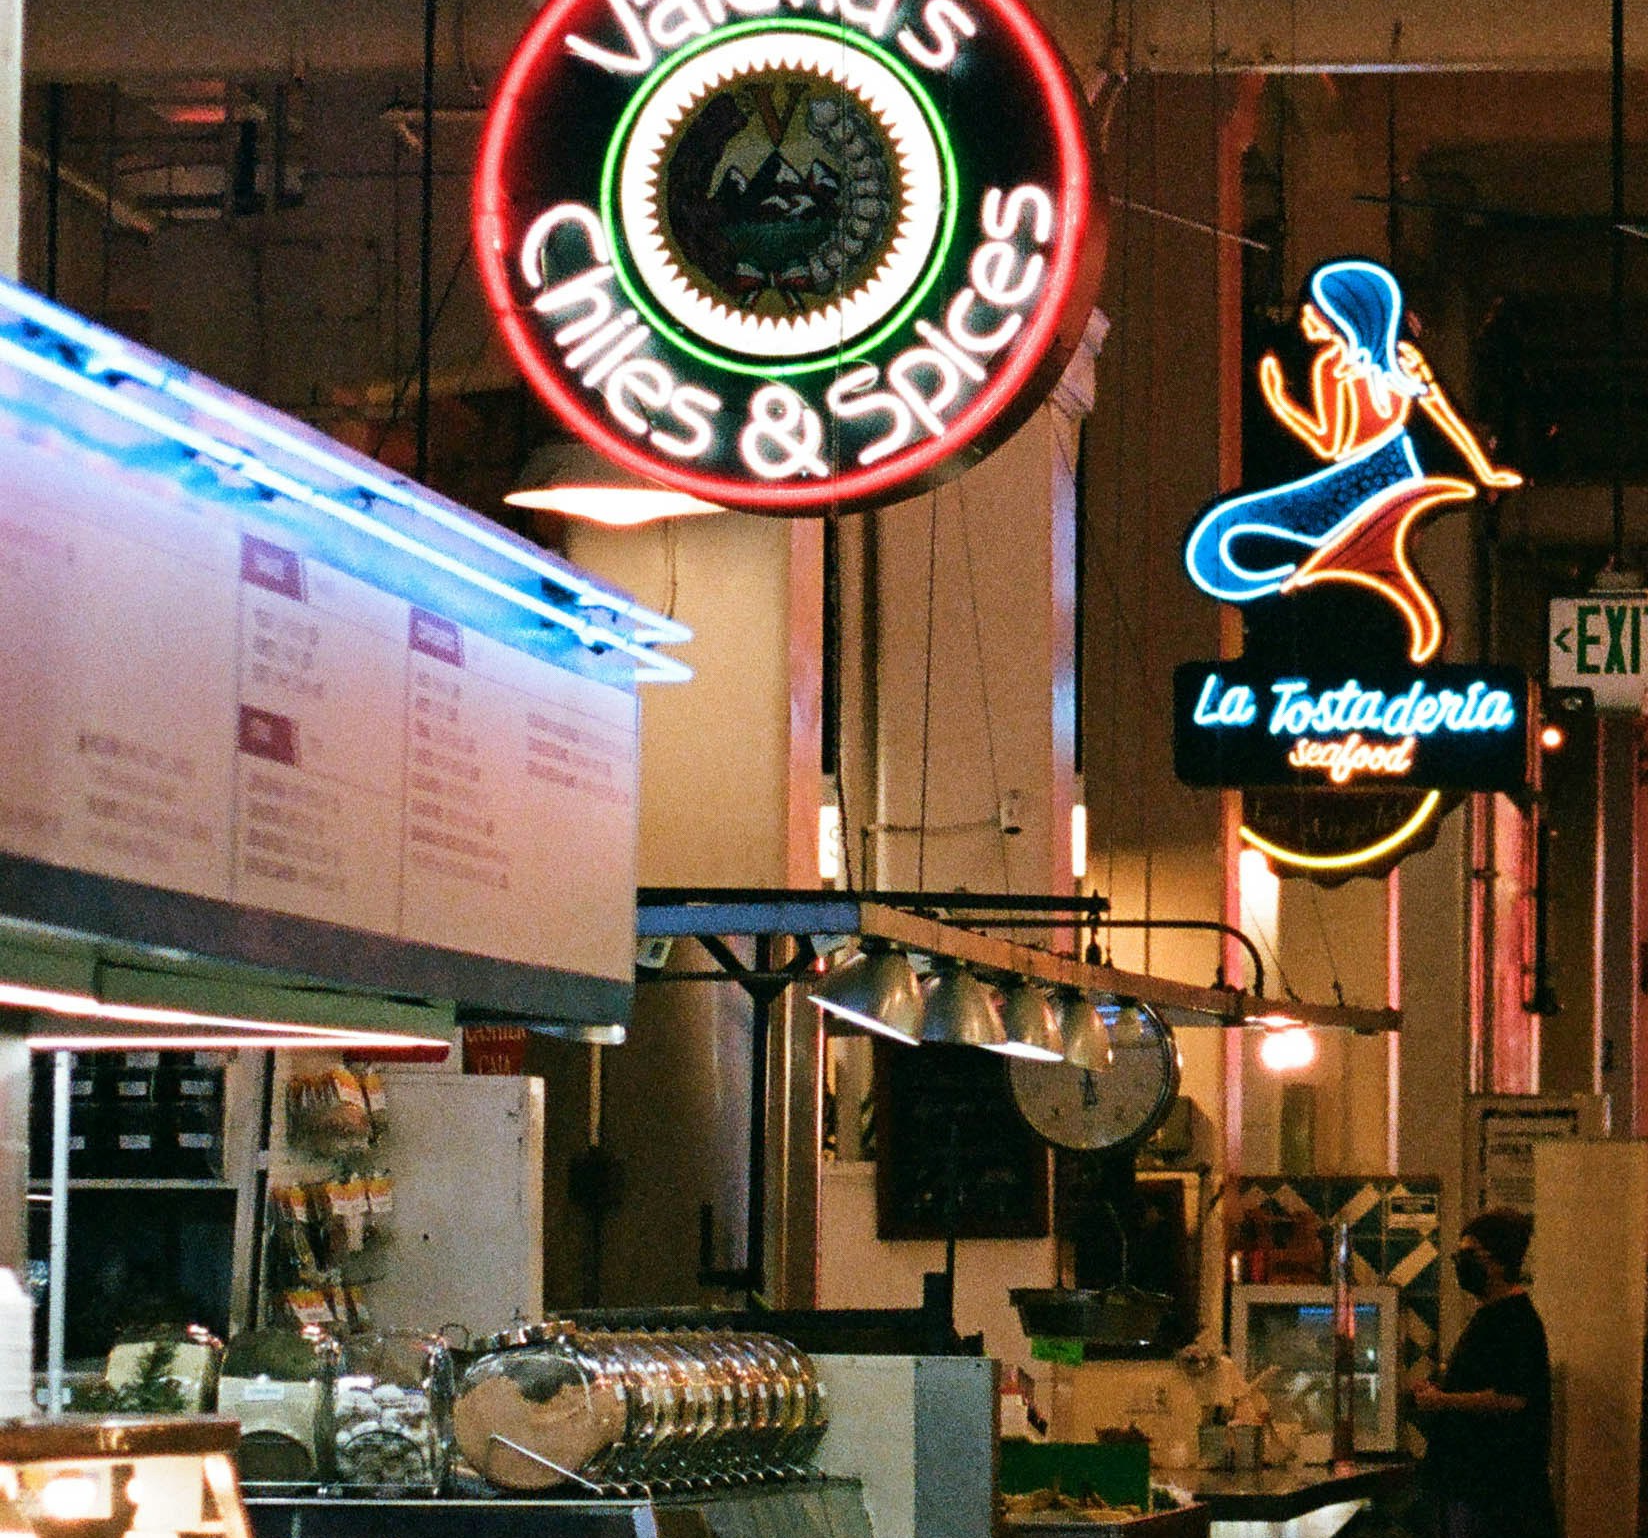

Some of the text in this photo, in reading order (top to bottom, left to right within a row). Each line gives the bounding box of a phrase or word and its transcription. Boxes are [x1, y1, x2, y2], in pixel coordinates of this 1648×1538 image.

[520, 182, 1054, 480] Chiles & Spices
[1192, 672, 1257, 728] La
[1287, 731, 1416, 784] seafood
